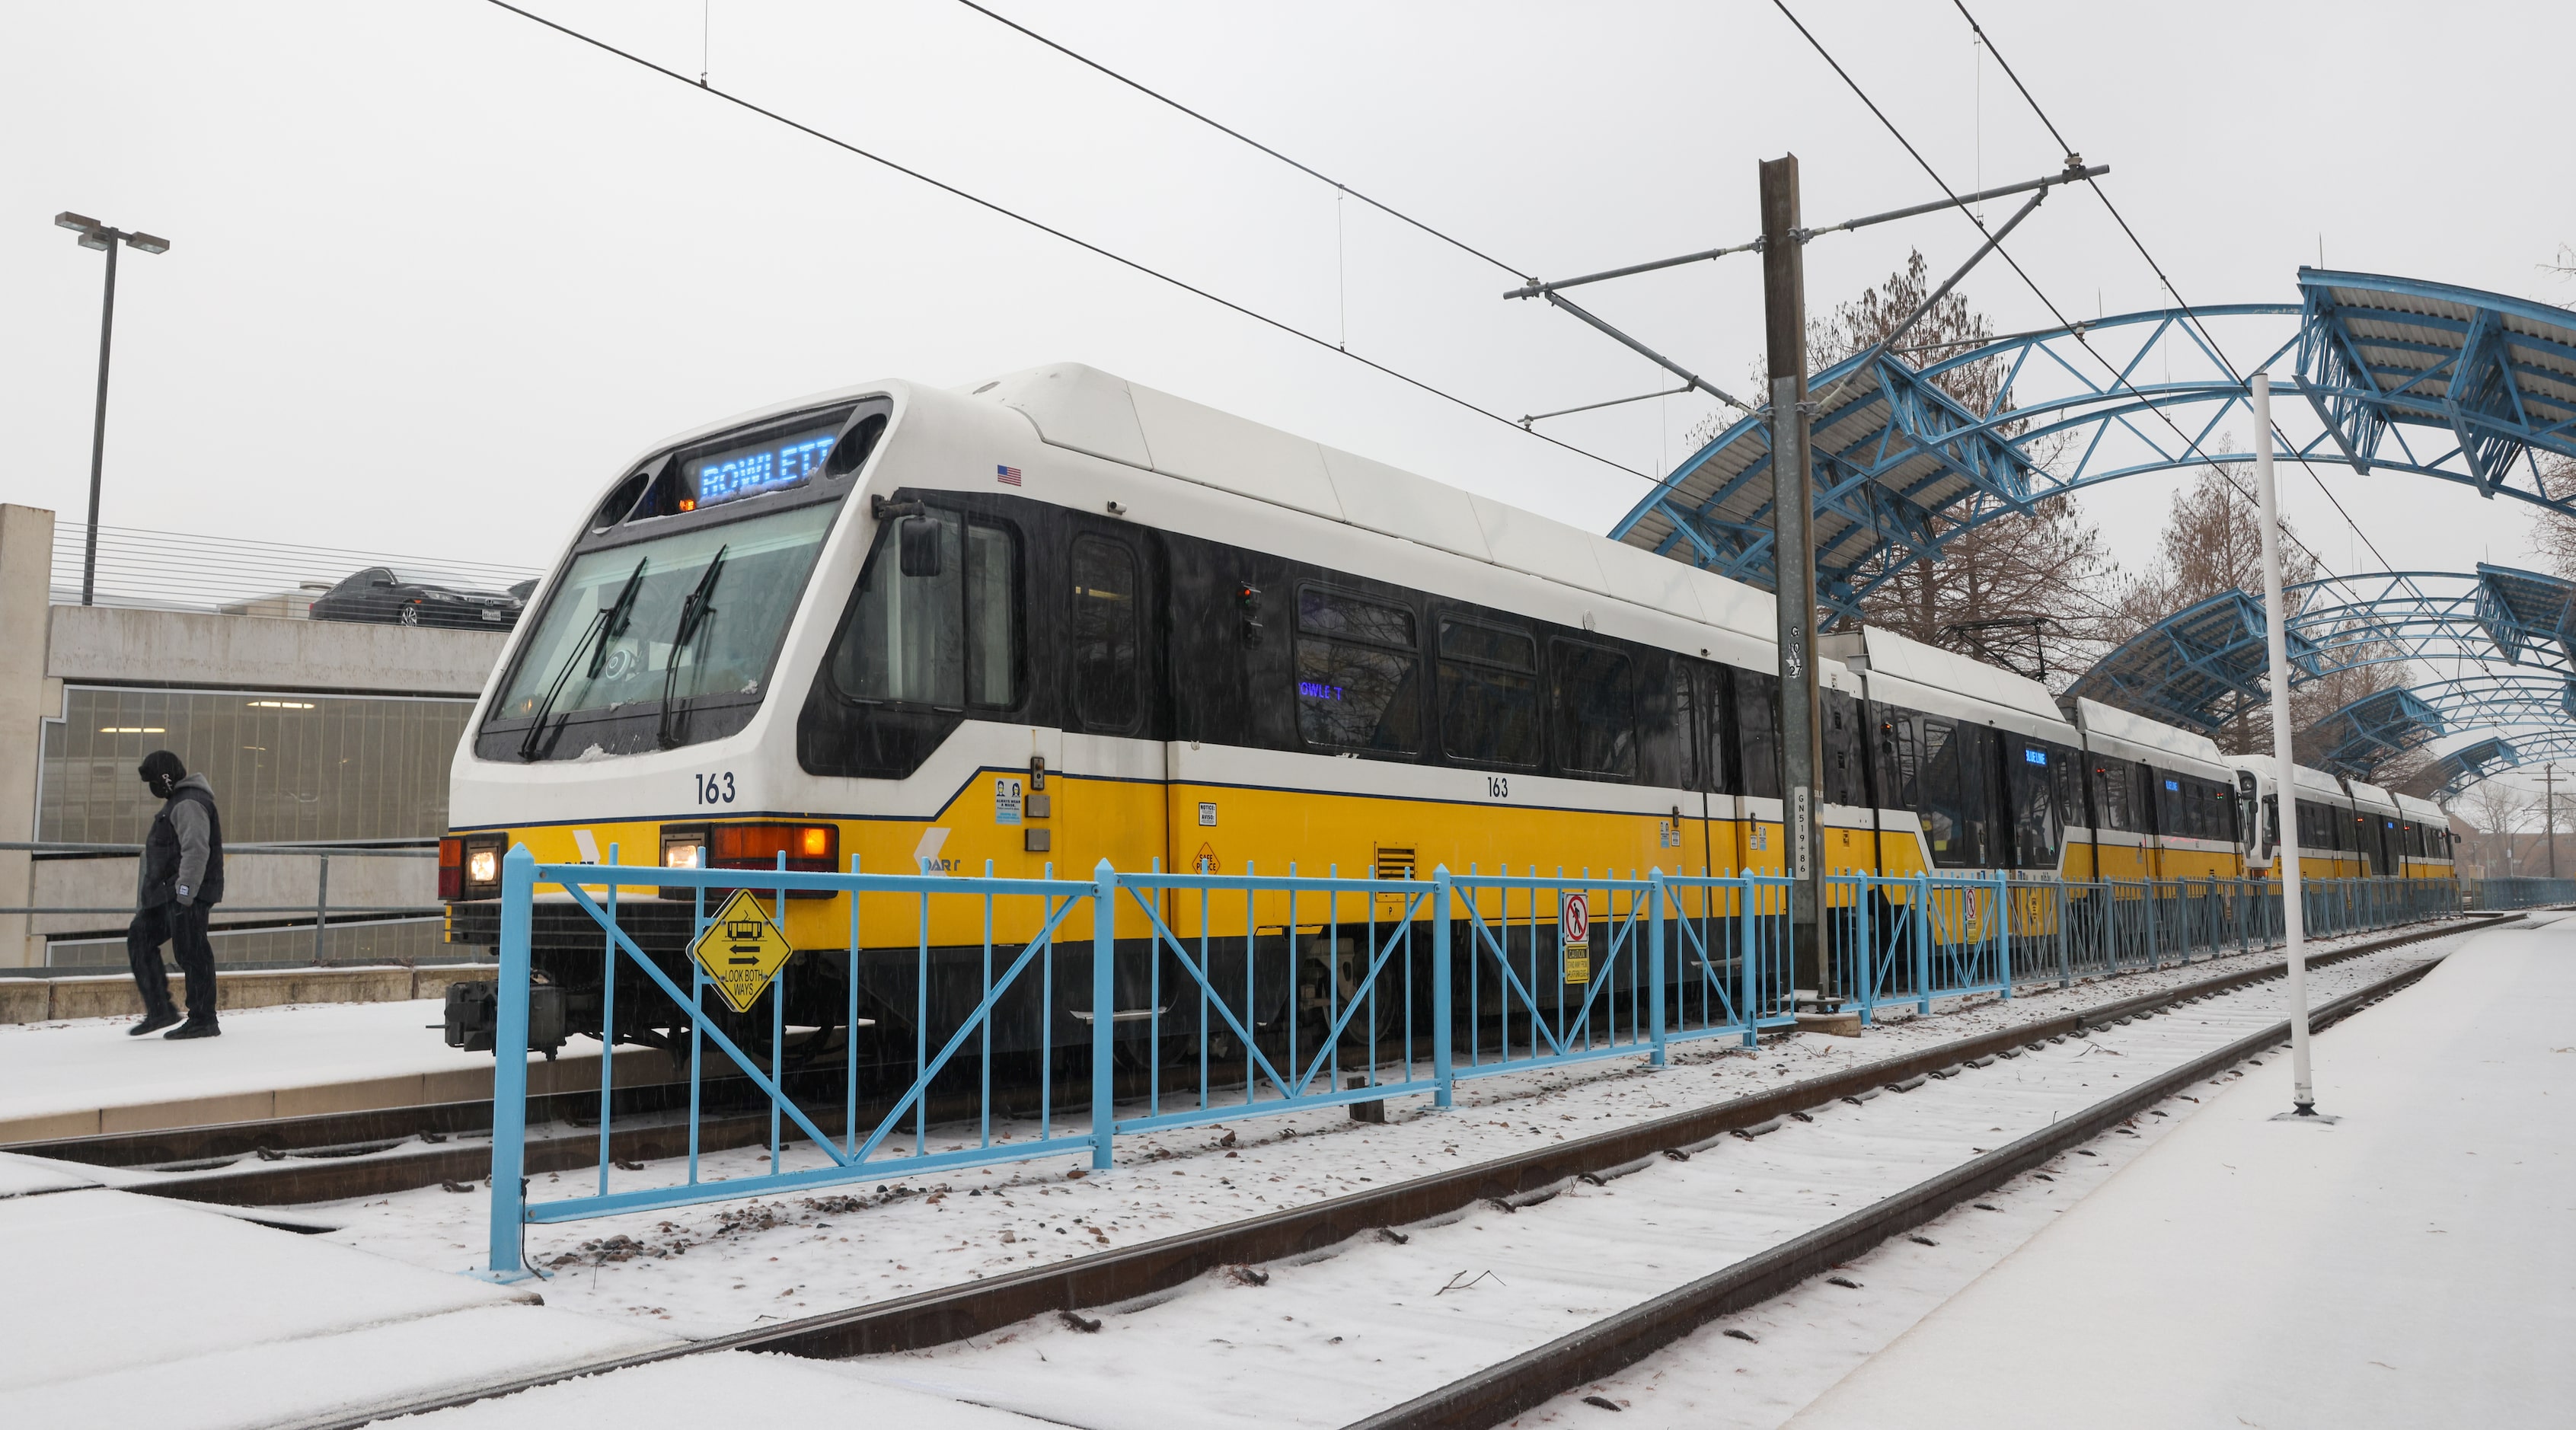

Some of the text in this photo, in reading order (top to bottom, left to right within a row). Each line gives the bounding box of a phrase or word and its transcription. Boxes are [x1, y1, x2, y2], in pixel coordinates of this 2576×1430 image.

[1791, 626, 1799, 637] G
[1789, 666, 1802, 676] 27
[695, 771, 736, 805] 163
[1487, 777, 1508, 798] 163
[1569, 950, 1585, 959] CAUTION
[725, 969, 763, 982] LOOK BOTH
[734, 983, 754, 996] WAYS
